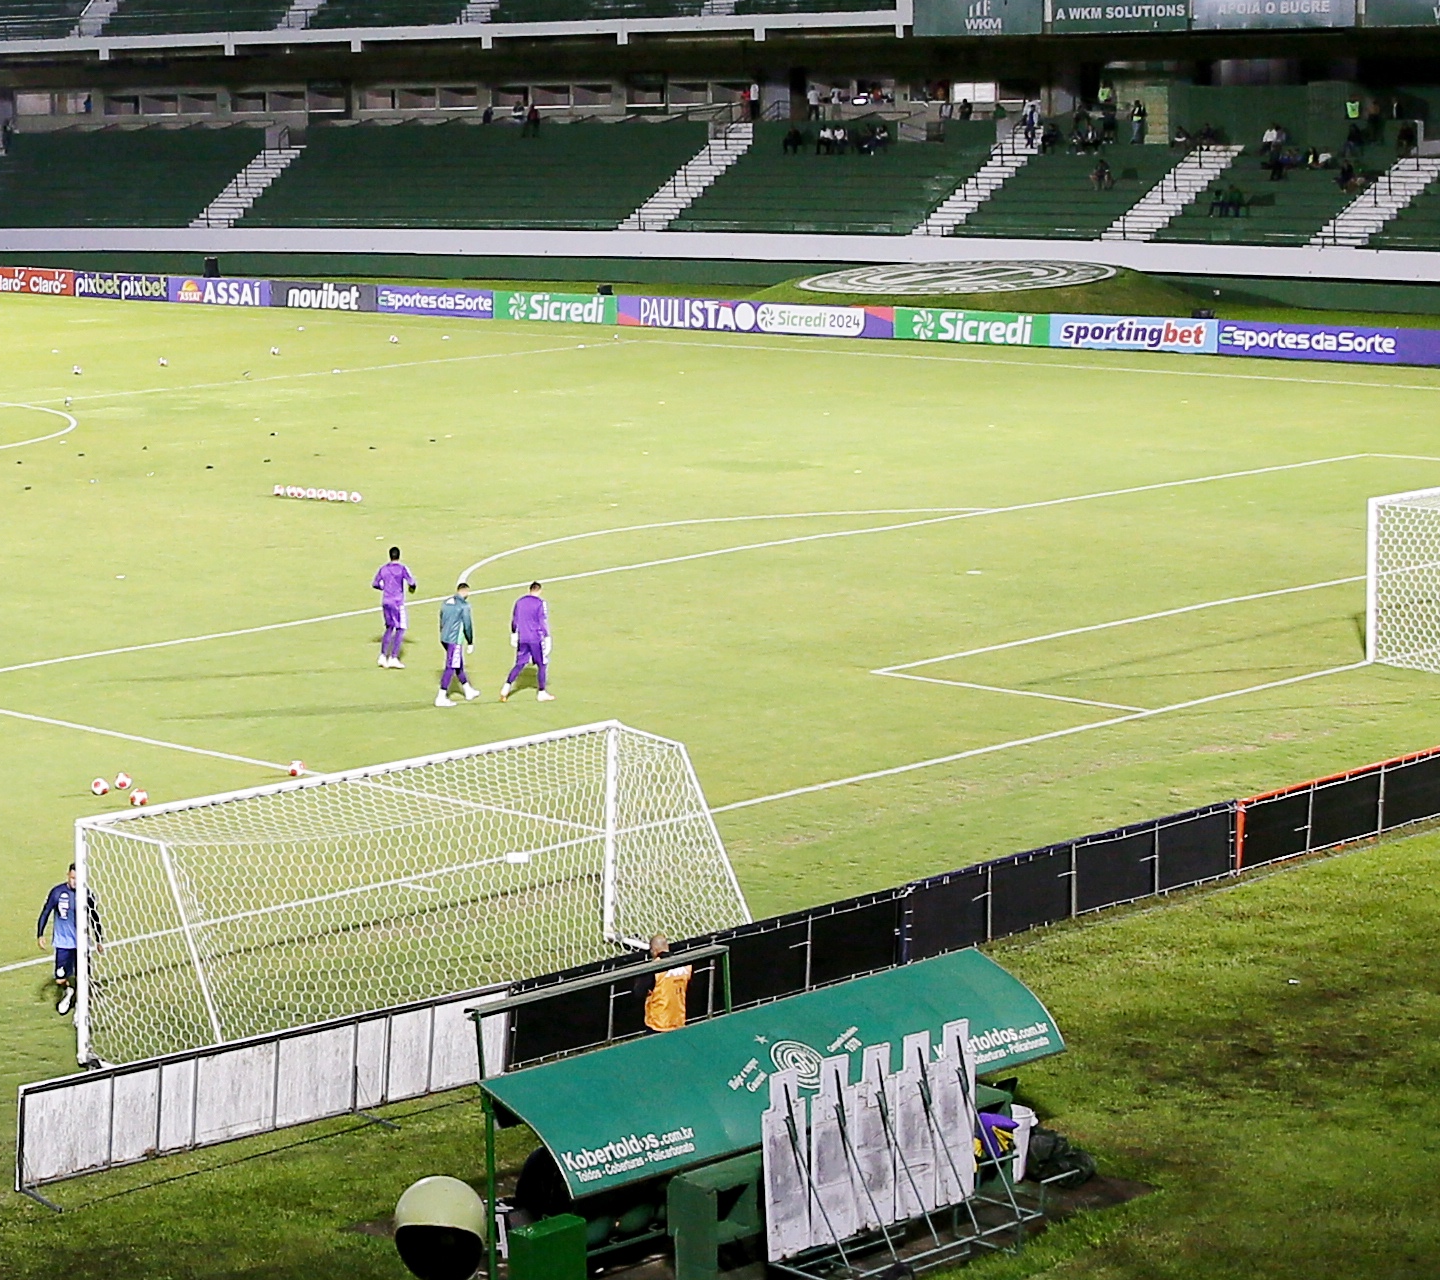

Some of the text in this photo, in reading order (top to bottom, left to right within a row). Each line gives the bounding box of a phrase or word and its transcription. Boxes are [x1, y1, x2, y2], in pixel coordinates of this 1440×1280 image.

[1056, 4, 1186, 21] A WKM SOLUTIONS
[1265, 2, 1276, 15] O
[1280, 1, 1330, 15] BUGRE
[965, 18, 1002, 30] WKM
[29, 275, 60, 294] Claro
[75, 273, 120, 298] pixbet
[120, 275, 167, 300] pixbet
[288, 283, 360, 311] novibet
[529, 294, 604, 324] Sicredi
[777, 310, 860, 329] Sicredi 2024
[937, 311, 1032, 345] Sicredi
[1061, 320, 1205, 351] sportingbet
[933, 1022, 1049, 1061] Kertoldos.com.br
[576, 1142, 696, 1183] Toldos Coberturas Policarbonato
